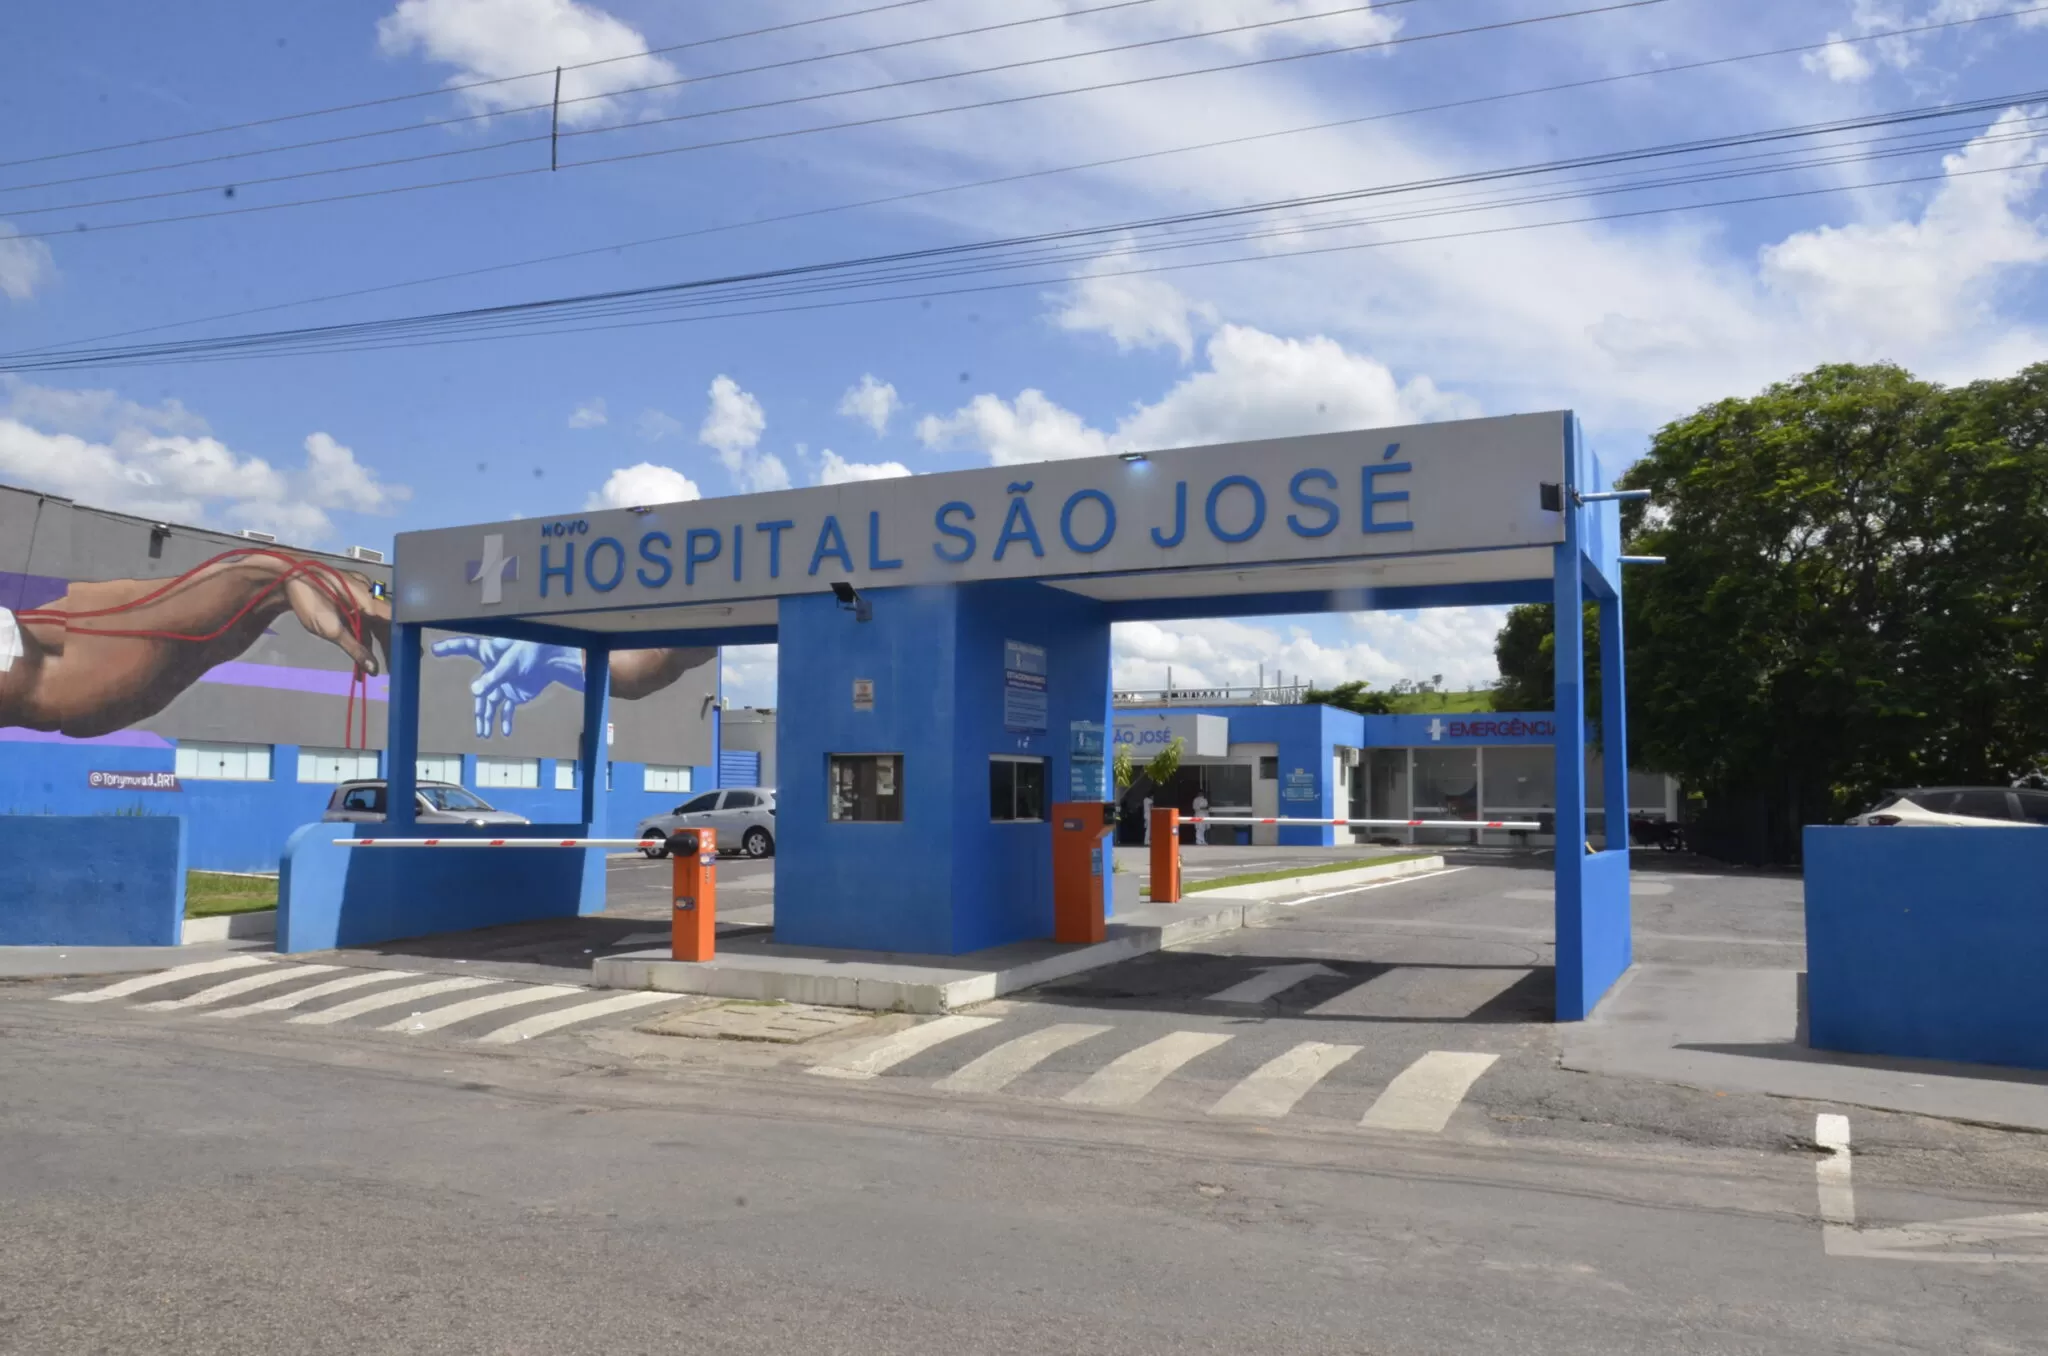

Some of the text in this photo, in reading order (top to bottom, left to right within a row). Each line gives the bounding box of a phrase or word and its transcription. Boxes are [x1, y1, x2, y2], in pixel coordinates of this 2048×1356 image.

[539, 444, 1415, 598] HOSPITAL SÃO JOSÉ
[541, 519, 589, 538] NOVO
[1112, 726, 1172, 746] ÃO JOSÉ
